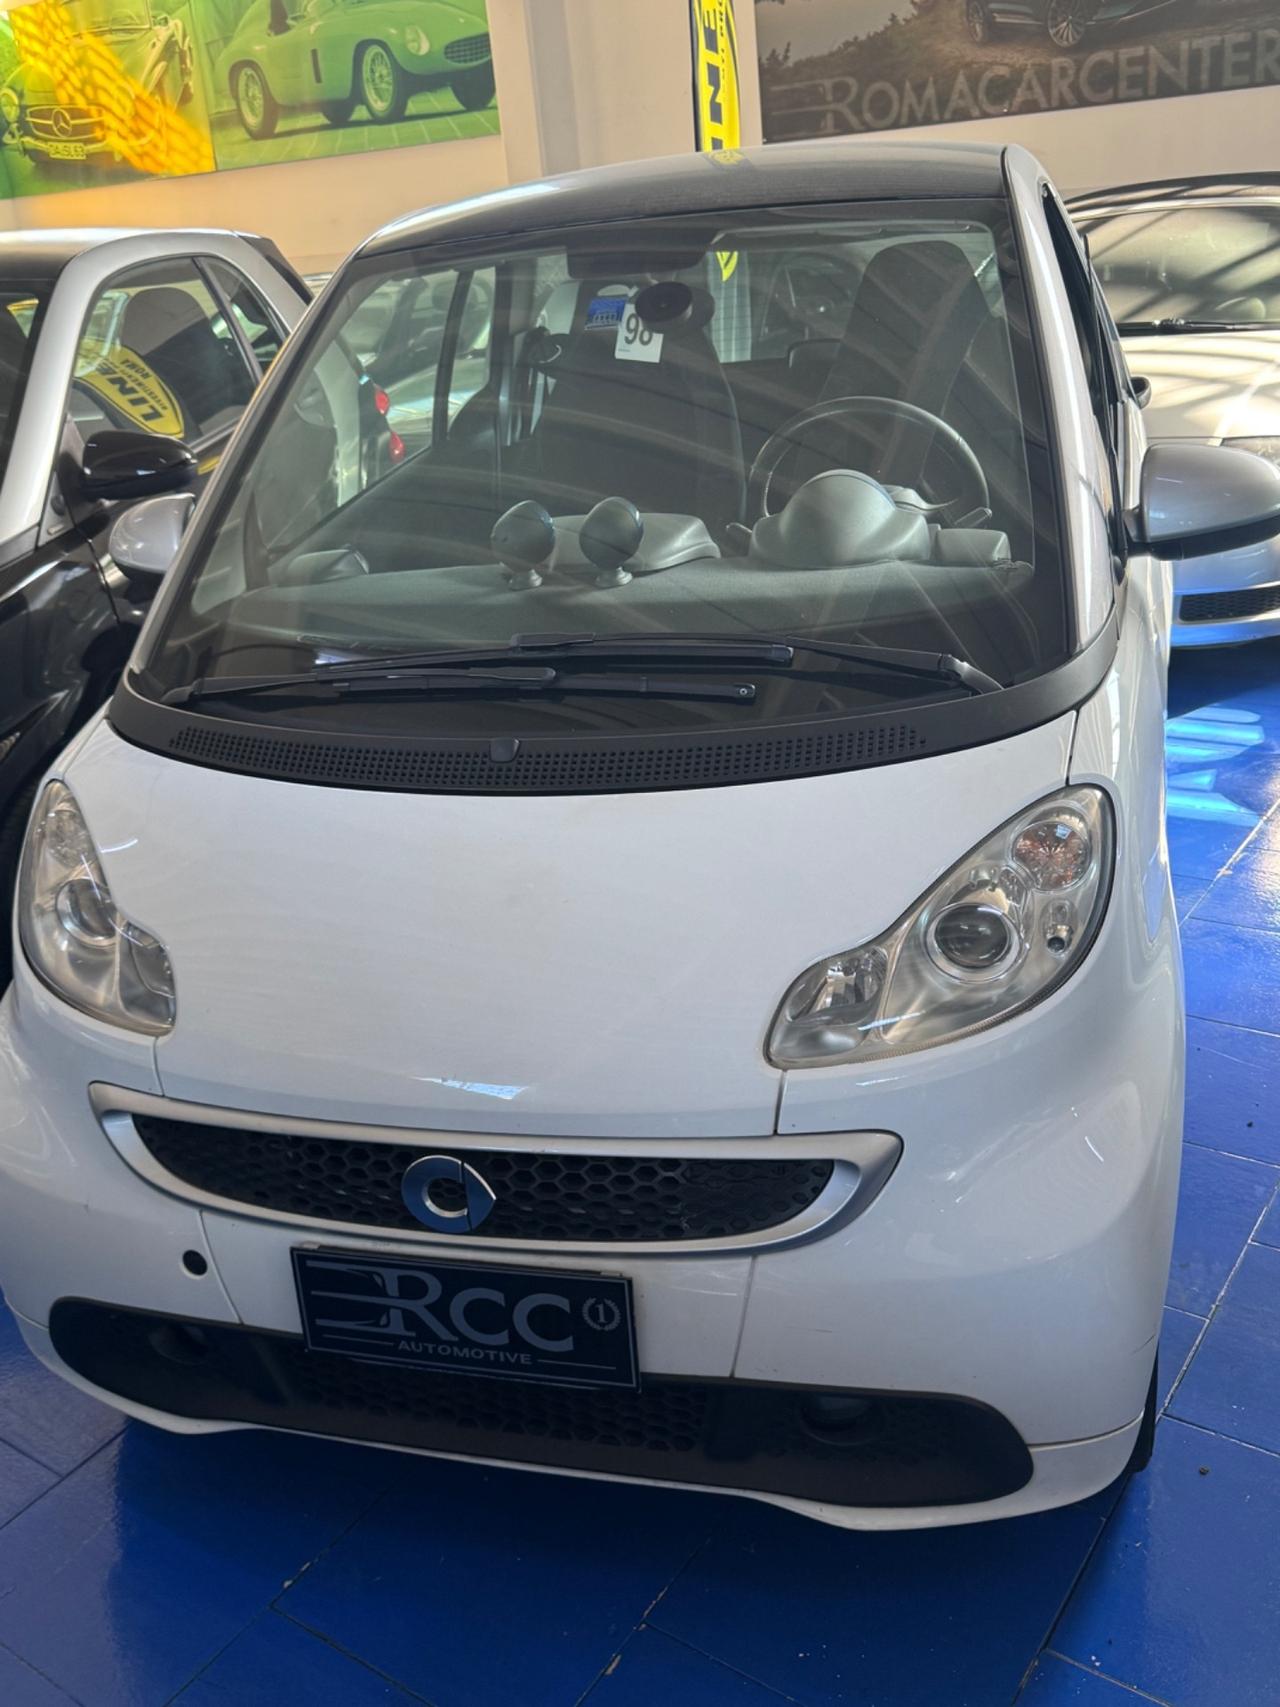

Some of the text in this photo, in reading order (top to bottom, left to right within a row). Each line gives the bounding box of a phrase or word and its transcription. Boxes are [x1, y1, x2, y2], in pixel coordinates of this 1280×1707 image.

[703, 9, 723, 150] INE
[815, 28, 1280, 134] ROMACARCENTER
[370, 1267, 576, 1352] RCC
[397, 1340, 533, 1365] AUTOMOTIVE
